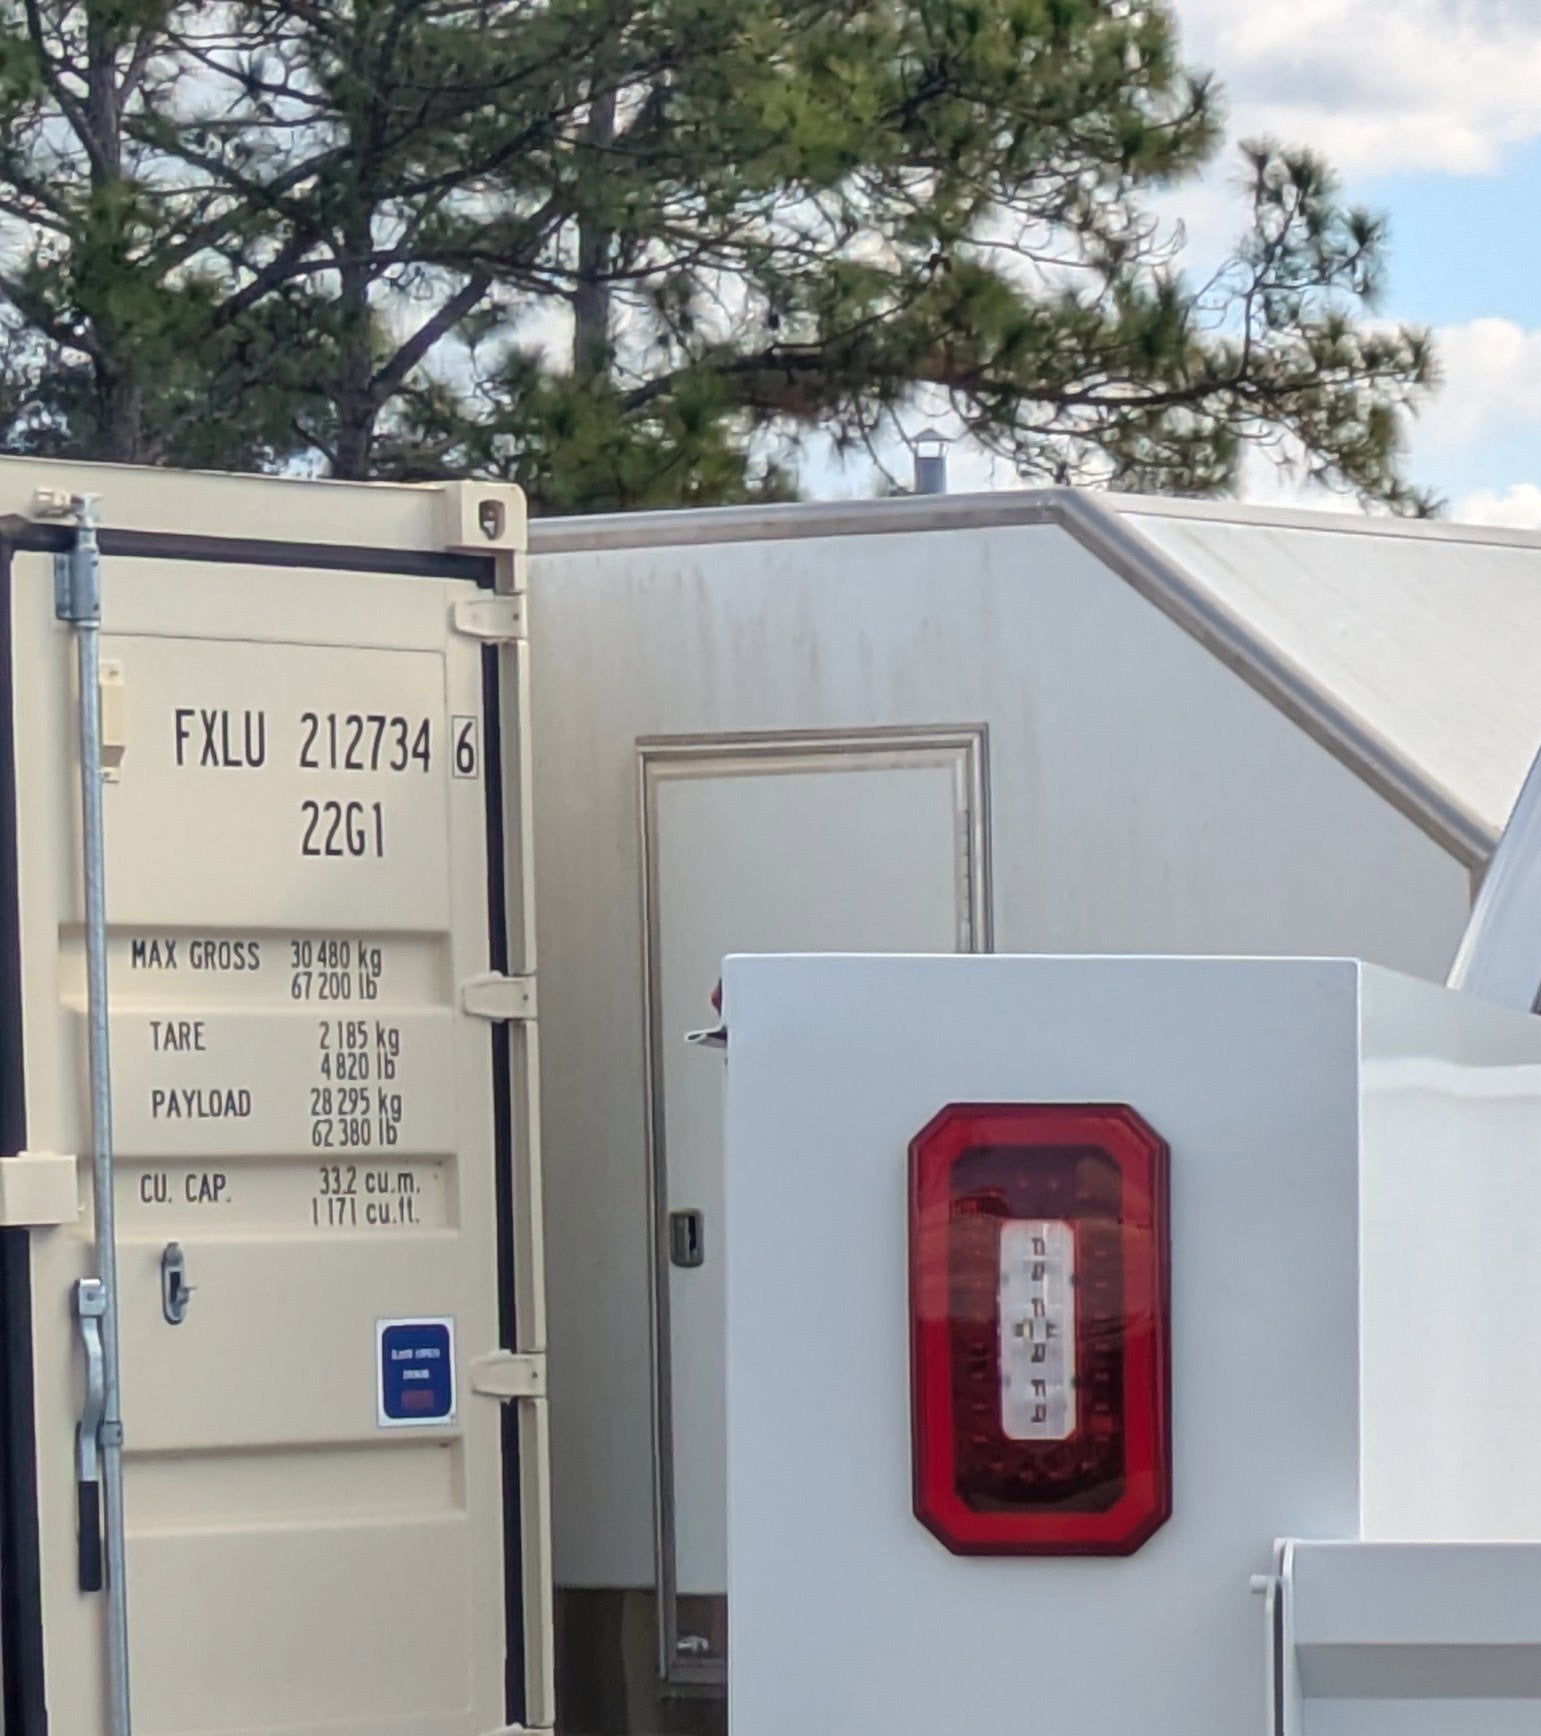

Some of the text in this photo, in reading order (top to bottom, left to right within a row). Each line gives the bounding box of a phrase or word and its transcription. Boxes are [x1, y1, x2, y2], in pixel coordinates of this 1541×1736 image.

[174, 708, 475, 774] FXLU 212734 6
[301, 800, 384, 858] 22G1
[131, 938, 178, 970] MAX
[189, 940, 261, 971] GROSS
[358, 940, 382, 978] kg
[359, 971, 378, 1000] lb
[149, 1021, 207, 1052] TARE
[375, 1021, 400, 1057] kg
[377, 1052, 395, 1080] lb
[152, 1088, 252, 1119] PAYLOAD
[378, 1086, 402, 1123] kg
[379, 1118, 398, 1145] lb
[139, 1173, 173, 1204] CU.
[184, 1173, 232, 1203] CAP.
